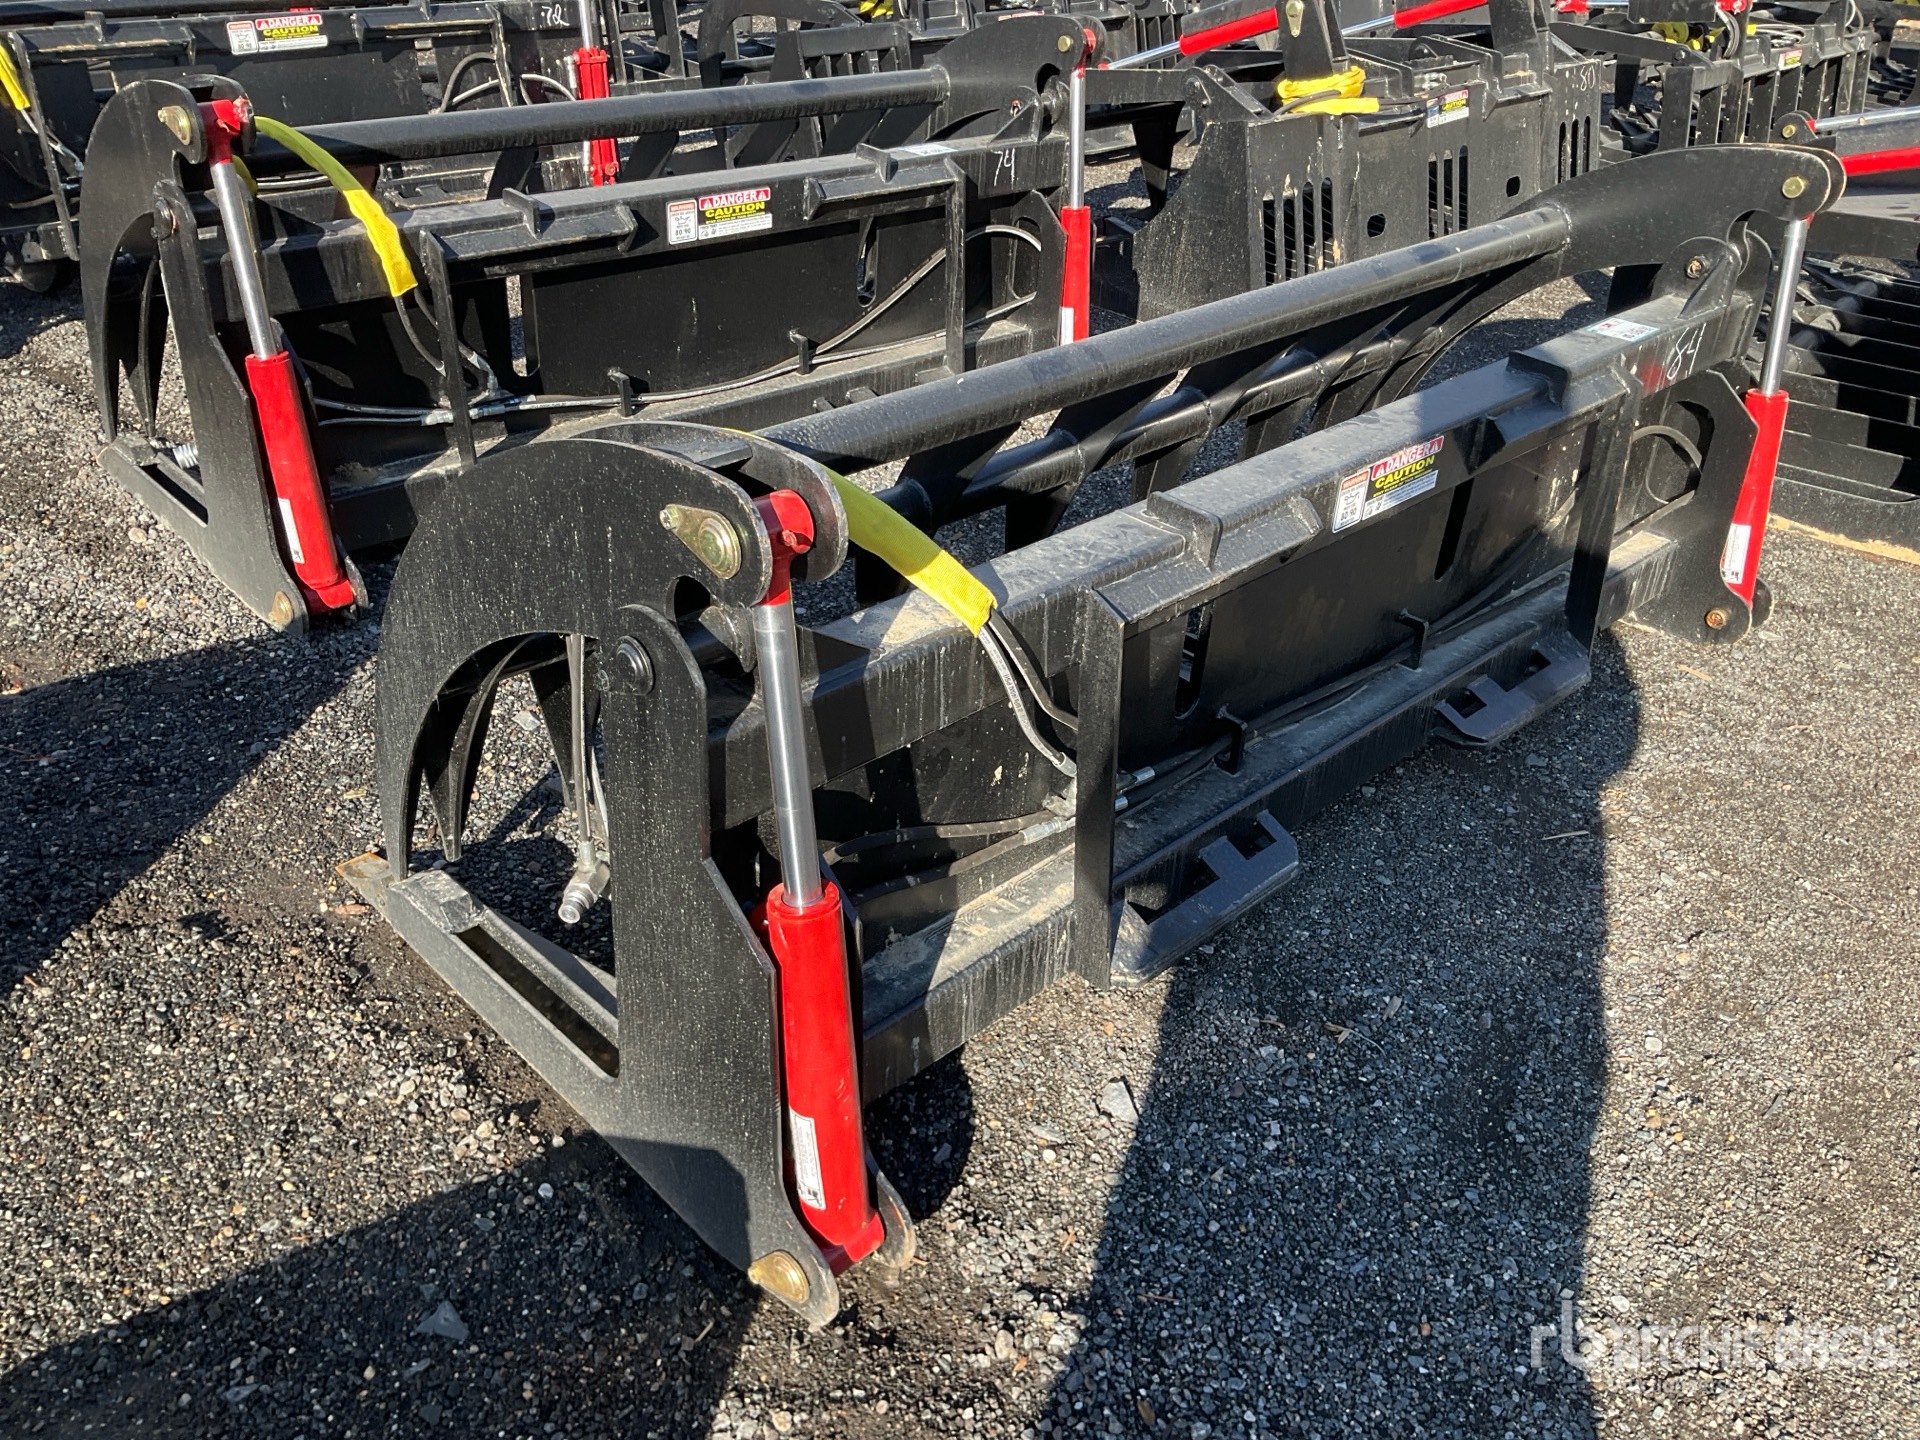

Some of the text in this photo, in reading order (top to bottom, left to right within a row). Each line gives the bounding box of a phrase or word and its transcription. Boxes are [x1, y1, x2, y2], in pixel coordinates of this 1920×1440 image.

[263, 26, 318, 36] CAUTION
[268, 16, 309, 28] DANGER
[1580, 65, 1596, 91] 80
[990, 148, 1016, 190] 74
[705, 202, 765, 218] CAUTION
[713, 191, 758, 207] DANGER
[1666, 322, 1707, 379] 84
[1386, 442, 1430, 472] DANGER
[1375, 455, 1435, 488] CAUTION
